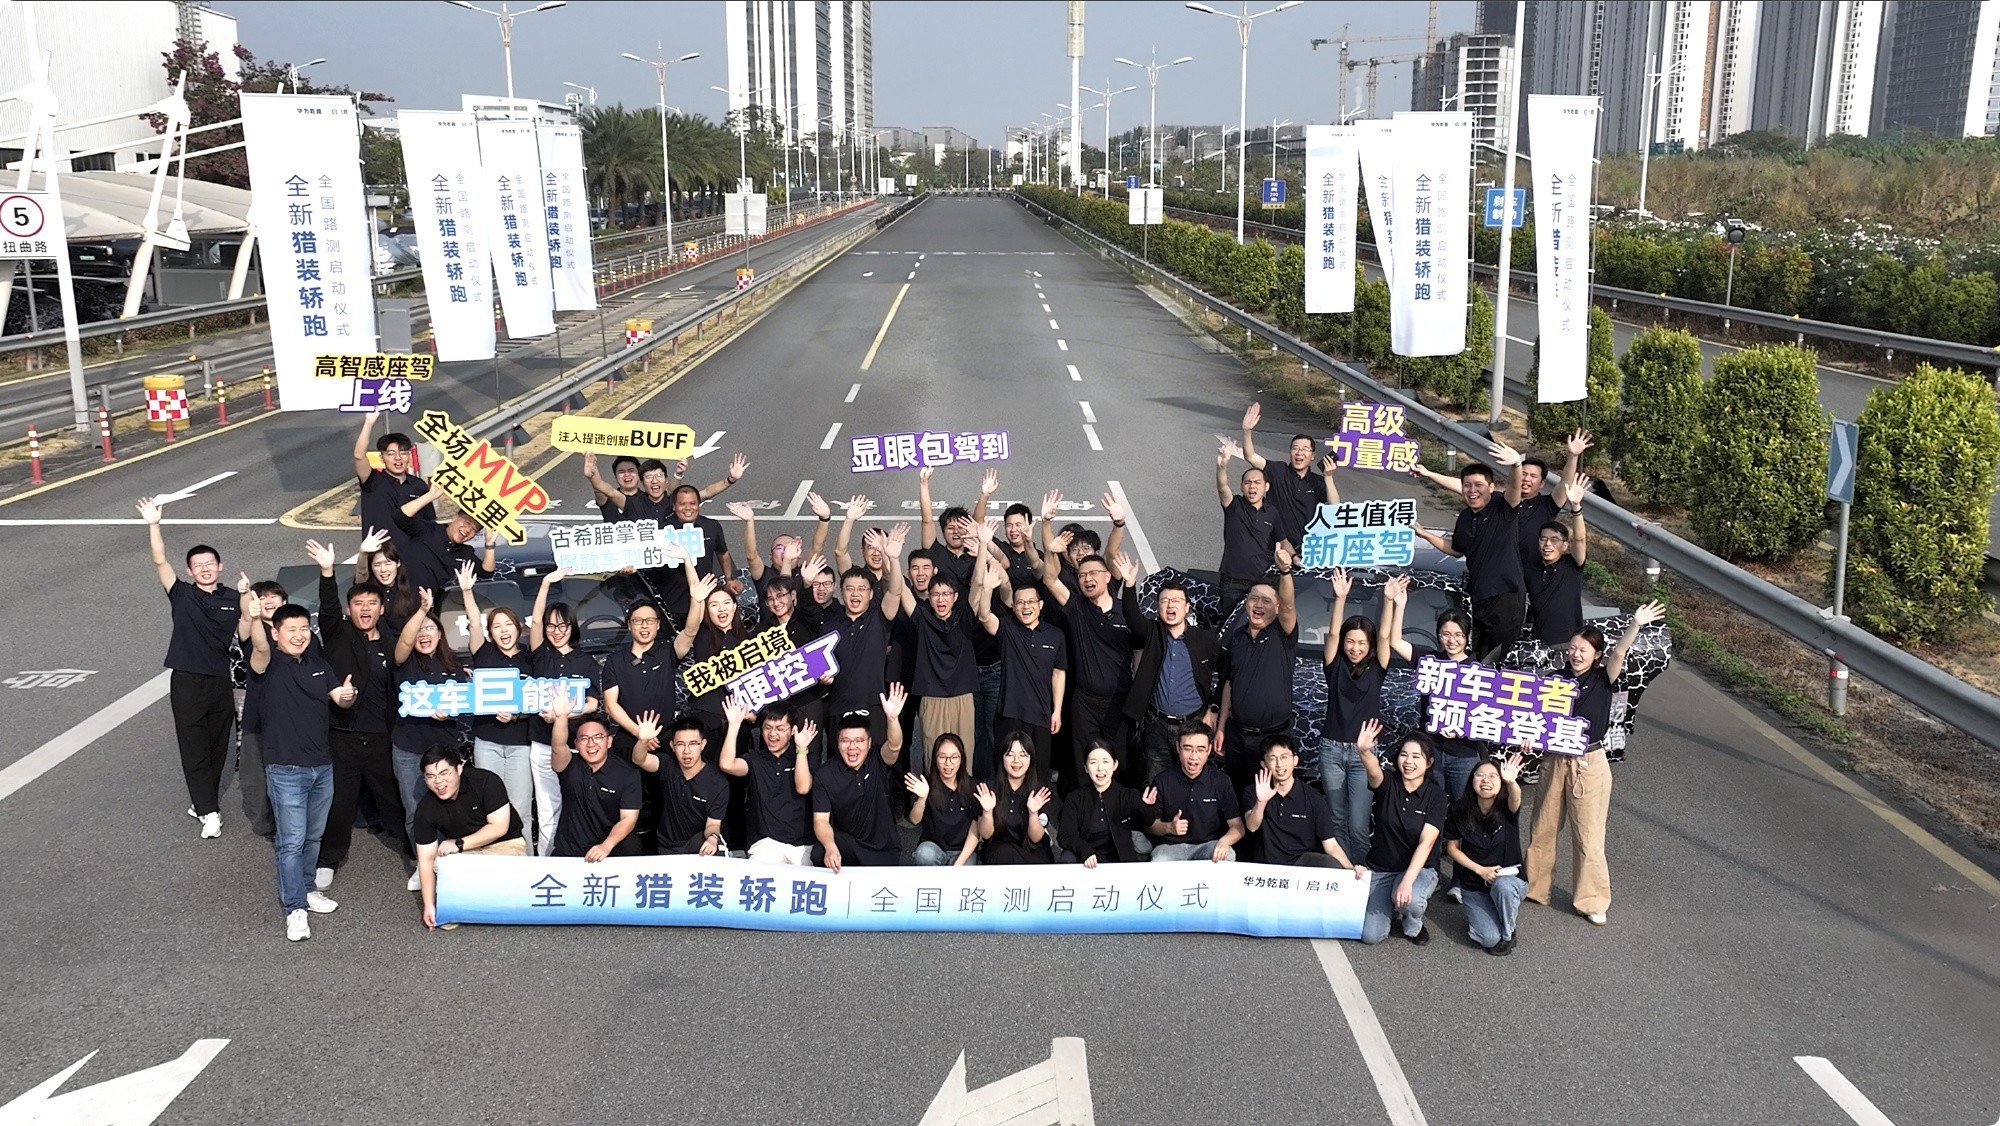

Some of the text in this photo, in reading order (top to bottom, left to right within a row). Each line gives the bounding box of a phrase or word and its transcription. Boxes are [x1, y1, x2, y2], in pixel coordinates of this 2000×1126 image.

[14, 207, 29, 226] 5
[431, 173, 467, 303] 全新猎装轿跑
[498, 175, 528, 287] 全新猎装轿跑
[1322, 172, 1335, 270] 全新猎装轿跑
[1414, 173, 1432, 301] 全新猎装轿跑
[3, 241, 47, 253] 扭曲路
[285, 174, 328, 337] 全新猎装轿跑
[318, 174, 350, 337] 全国路测启动仪式
[315, 355, 431, 378] 高智感座驾
[340, 379, 412, 413] 上线
[1342, 403, 1405, 437] 高级
[851, 432, 1009, 473] 显眼包驾到
[1325, 438, 1420, 473] 力量感
[434, 462, 509, 530] 在这里
[1306, 501, 1415, 530] 人生值得
[552, 521, 656, 549] 古希腊掌管
[1302, 530, 1414, 567] 新座驾
[686, 630, 792, 693] 我被启境
[728, 633, 840, 713] 硬控了
[1416, 657, 1579, 716] 新车王者
[1427, 698, 1589, 756] 预备登基
[530, 873, 1209, 916] 全新猎装轿跑 全国路测启动仪式
[1305, 880, 1339, 892] 启境
